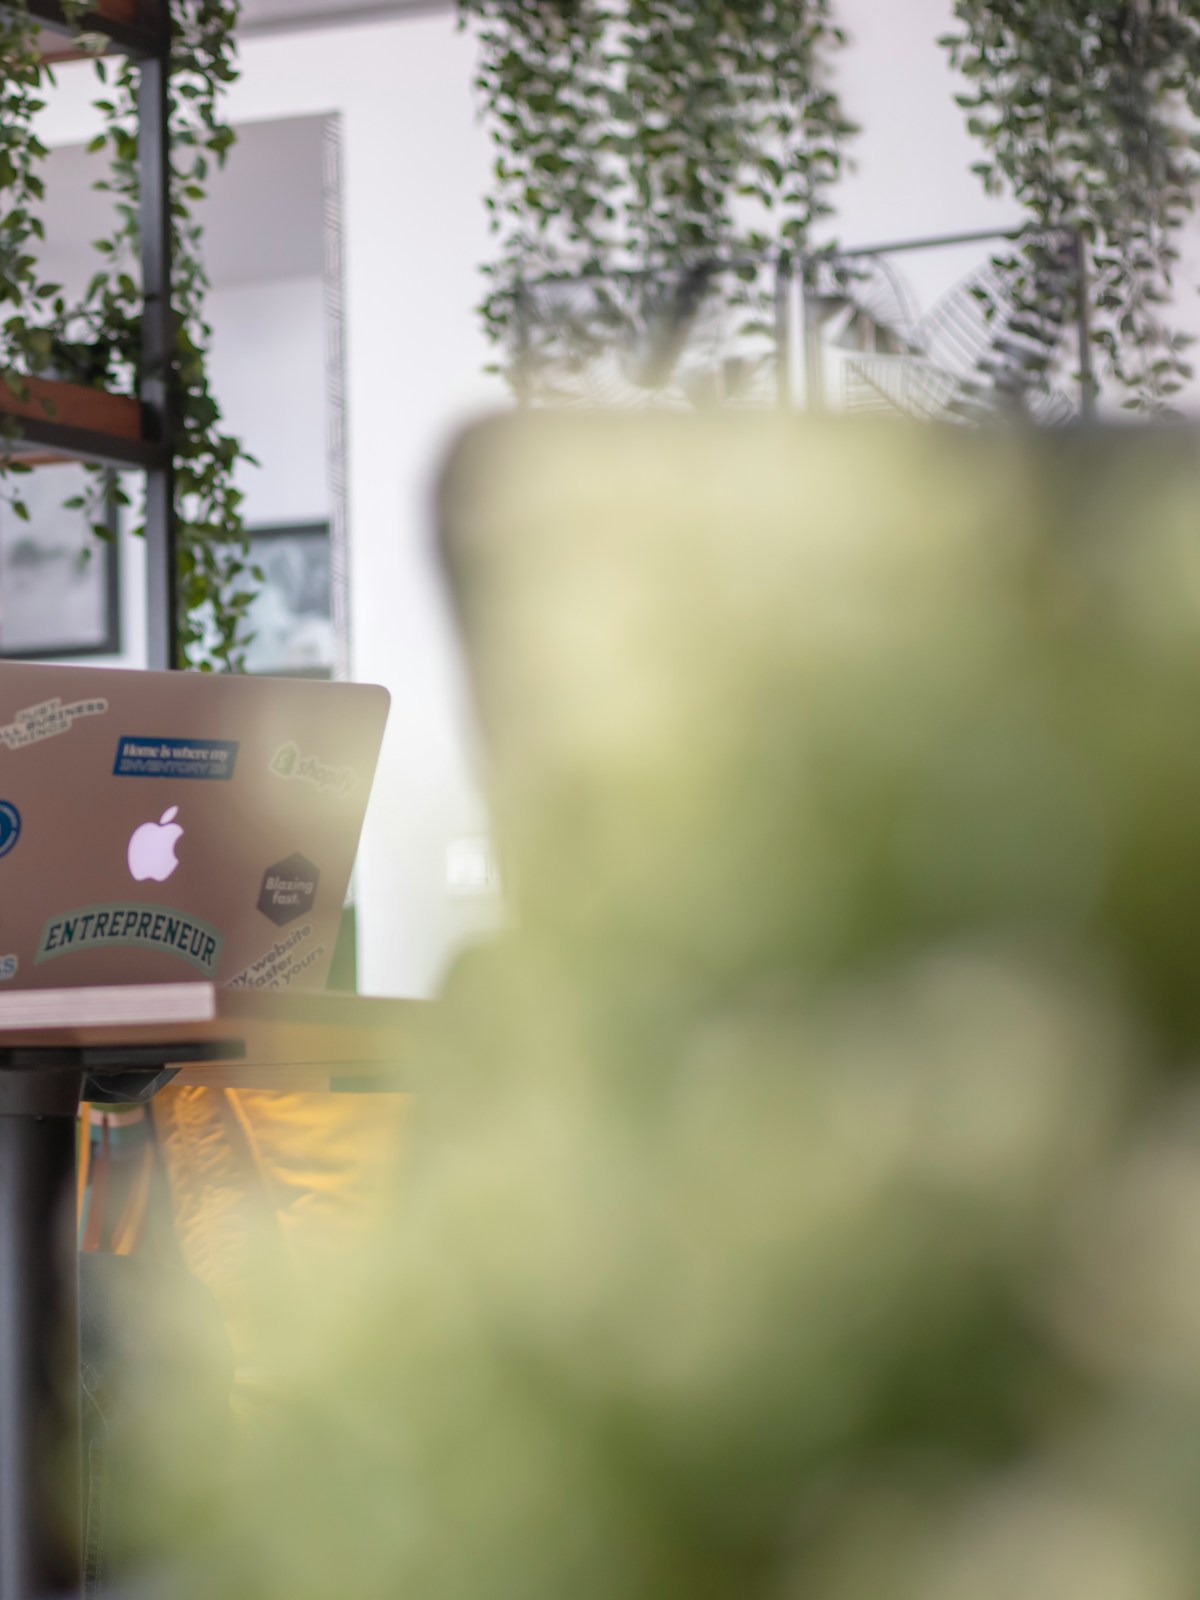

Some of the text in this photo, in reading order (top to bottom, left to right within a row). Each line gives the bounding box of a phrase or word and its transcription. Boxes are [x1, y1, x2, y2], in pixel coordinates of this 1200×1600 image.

[26, 703, 104, 730] BUSINESS
[123, 743, 228, 762] Home is where my
[119, 759, 208, 774] INVENTORY
[296, 758, 355, 795] shopify
[266, 876, 314, 895] Blazing
[272, 890, 300, 905] fast.
[44, 909, 216, 966] ENTREPRENEUR
[251, 925, 311, 972] website
[281, 945, 325, 985] yours
